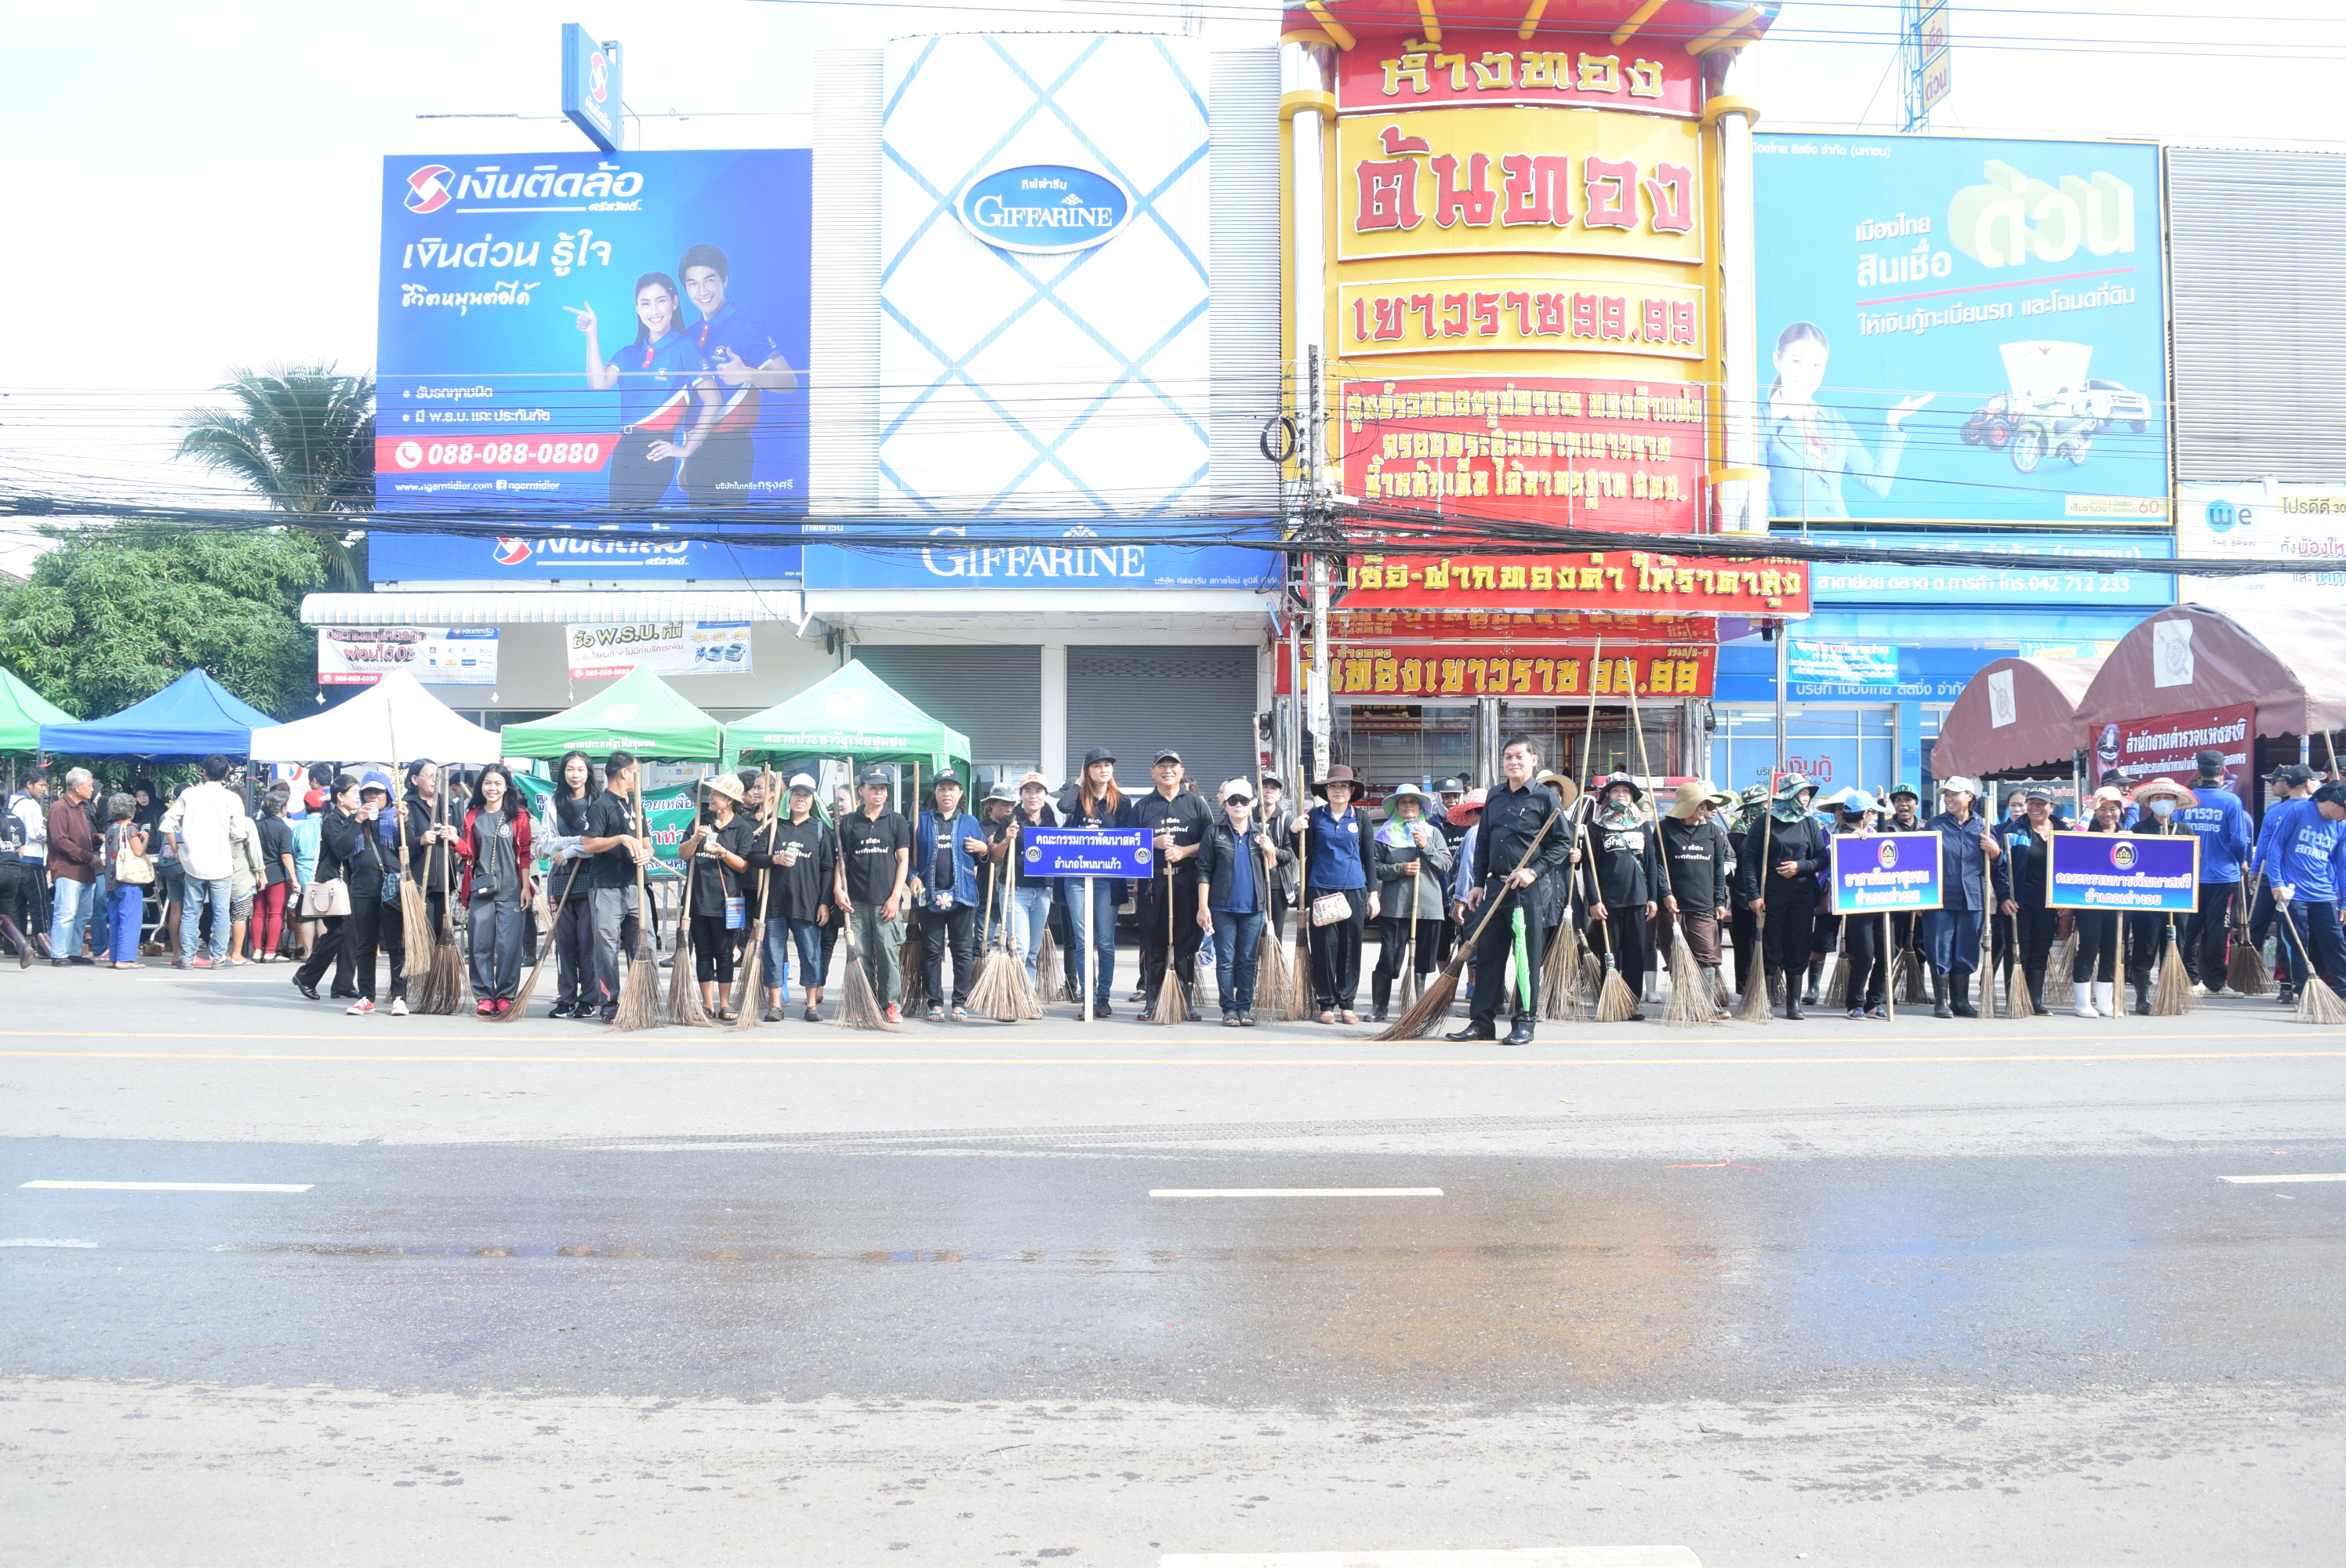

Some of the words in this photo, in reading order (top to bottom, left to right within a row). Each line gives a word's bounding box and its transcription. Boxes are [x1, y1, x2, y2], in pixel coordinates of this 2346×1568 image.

[1380, 38, 1664, 98] ห้างทอง
[1925, 68, 1947, 101] ด่วน
[1752, 141, 1788, 154] มืองไทย
[1821, 143, 1847, 155] จำกัด
[1850, 145, 1891, 158] (มหาชน)
[456, 162, 644, 199] เงินติดล้อ
[1021, 178, 1068, 191] กิฟฟารีน
[1353, 125, 1698, 234] ต้นทอง
[974, 195, 1113, 228] GIFFARINE
[1951, 160, 2135, 269] ด่วน
[1856, 212, 1931, 242] เมืองไทย
[402, 234, 540, 268] เงินด่วน
[551, 229, 612, 276] รู้ใจ
[1857, 238, 1952, 287] สินเชื่อ
[401, 281, 541, 316] ชีวิตหมุนต่อได้
[1858, 299, 2014, 337] ให้เงินกู้ทะเบียนรถ
[2021, 285, 2136, 319] และโฉนดที่ดิน
[1353, 292, 1698, 344] เยาวราช99.99
[416, 386, 493, 401] รับรถทุกชนิด
[416, 410, 425, 423] มี
[429, 412, 469, 423] พ.ร.บ.
[471, 411, 492, 423] และ
[494, 408, 550, 423] ประกันภัย
[428, 442, 599, 465] 088-088-0880
[1632, 470, 1688, 501] สคบ.
[2209, 508, 2253, 526] we
[2282, 497, 2330, 514] โปรดีดี
[921, 527, 1145, 578] GIFFARINE
[2281, 536, 2296, 554] ทั้ง
[1632, 553, 1801, 608] ให้ราคาสูง
[1817, 573, 1885, 590] สาขาย่อย
[2064, 576, 2094, 592] 712
[2099, 576, 2130, 592] 233
[573, 630, 595, 649] ซื้อ
[596, 624, 659, 646] พ.ร.บ.
[662, 622, 684, 640] ที่นี่
[343, 644, 396, 661] ผ่อนได้
[334, 673, 378, 682] 088-088-0880
[585, 668, 630, 677] 088-088-0880
[2126, 717, 2248, 753] สำนักงานตำรวจแห่งชาติ
[641, 793, 694, 811] ่วยเหลือ
[1036, 832, 1141, 847] คณะกรรมการพัฒนาสตรี
[1055, 855, 1121, 870] อำเภอโพนนาแก้ว
[2055, 872, 2192, 889] คณะกรรมการพัฒนาสตรี
[2085, 887, 2162, 906] อำเภอเต่างอย
